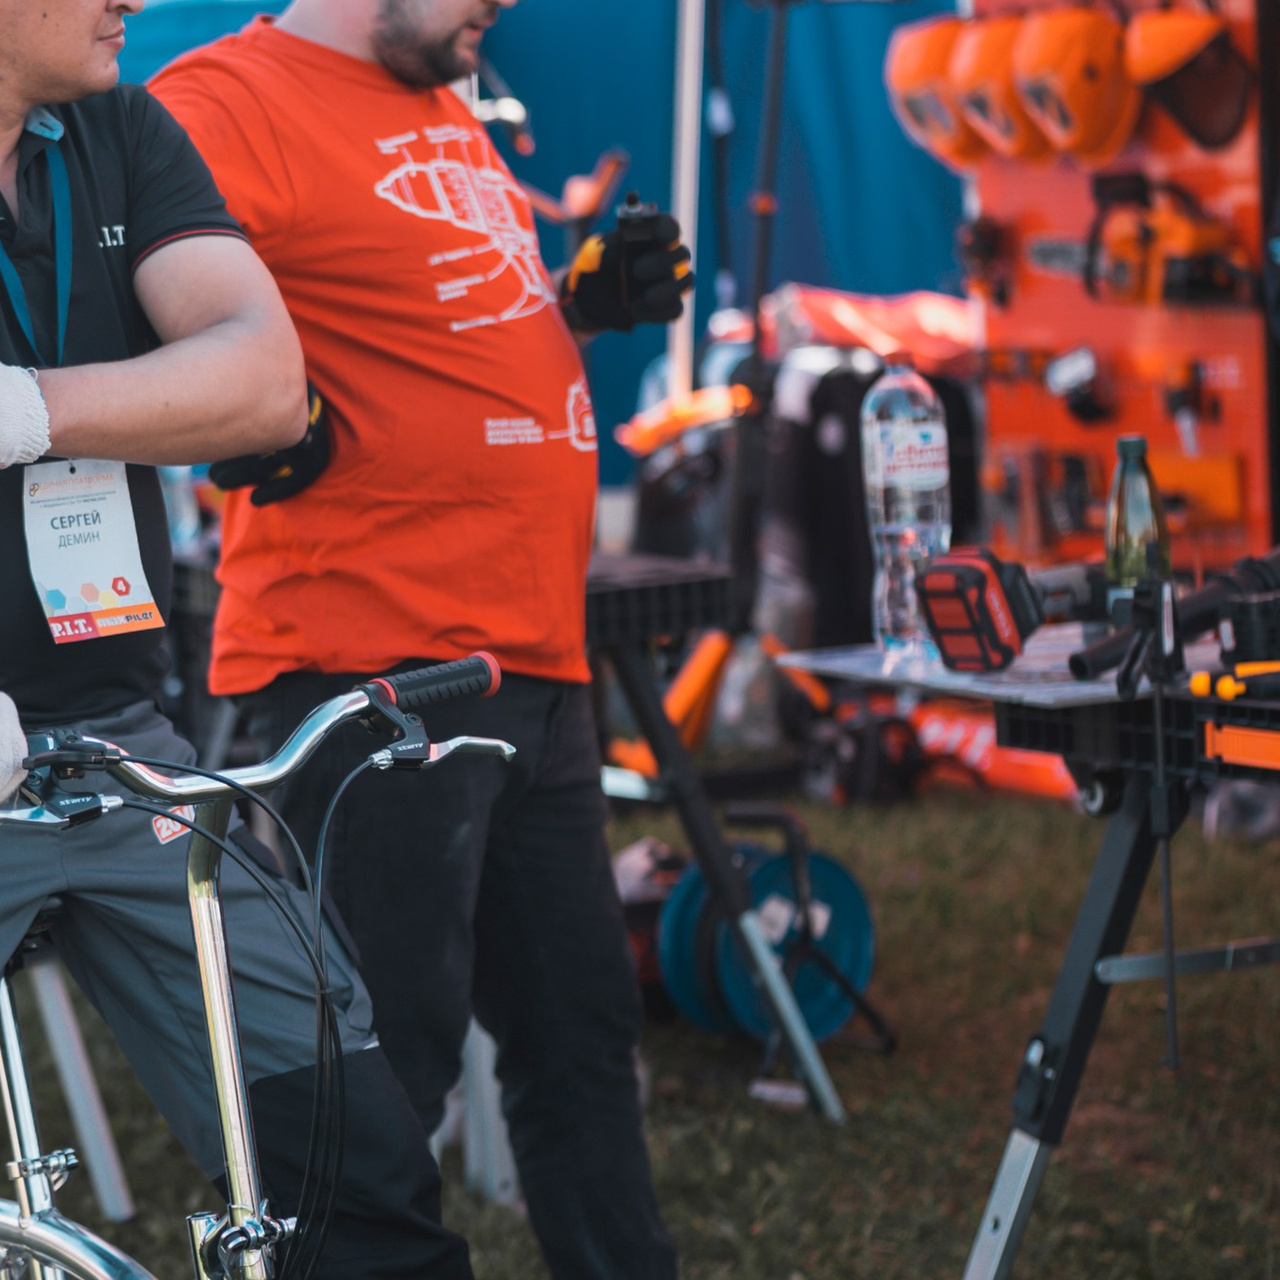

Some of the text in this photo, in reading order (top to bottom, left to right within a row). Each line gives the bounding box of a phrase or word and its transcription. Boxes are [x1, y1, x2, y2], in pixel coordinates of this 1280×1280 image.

[98, 225, 125, 248] .I.T
[50, 510, 102, 530] СЕРГЕЙ
[58, 531, 101, 549] ДЕМИН
[51, 619, 93, 637] P.I.T.
